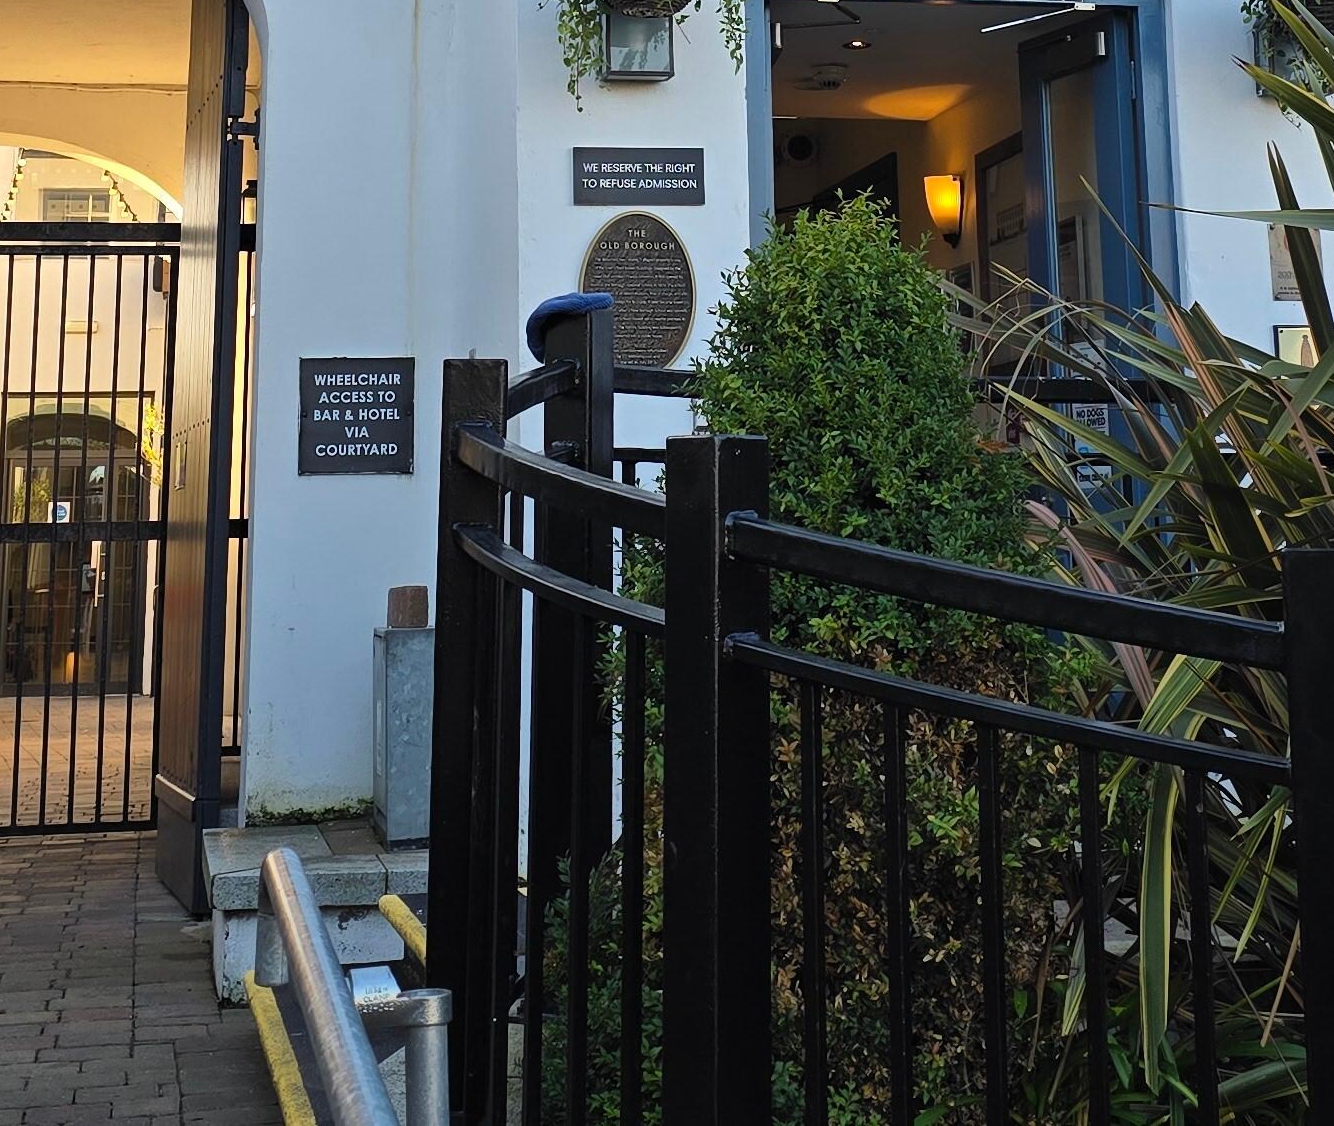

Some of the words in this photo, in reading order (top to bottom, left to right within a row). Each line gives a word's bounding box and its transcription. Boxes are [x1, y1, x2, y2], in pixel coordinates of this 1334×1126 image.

[582, 162, 599, 173] WE
[601, 163, 643, 173] RESERVE
[644, 163, 664, 173] THE
[665, 163, 696, 174] RIGHT
[582, 178, 598, 189] TO
[599, 178, 637, 189] REFUSE
[638, 179, 698, 189] ADMISSION
[627, 229, 647, 238] THE
[600, 241, 620, 250] OLD
[624, 242, 676, 251] BOROUGH
[314, 374, 401, 386] WHEELCHAIR
[318, 391, 374, 404] ACCESS
[377, 390, 396, 403] TO
[313, 409, 340, 421] BAR
[344, 409, 354, 421] &
[358, 408, 400, 421] HOTEL
[1076, 409, 1086, 419] NO
[1087, 408, 1105, 417] DOGS
[344, 426, 370, 438] VIA
[315, 443, 398, 456] COURTYARD
